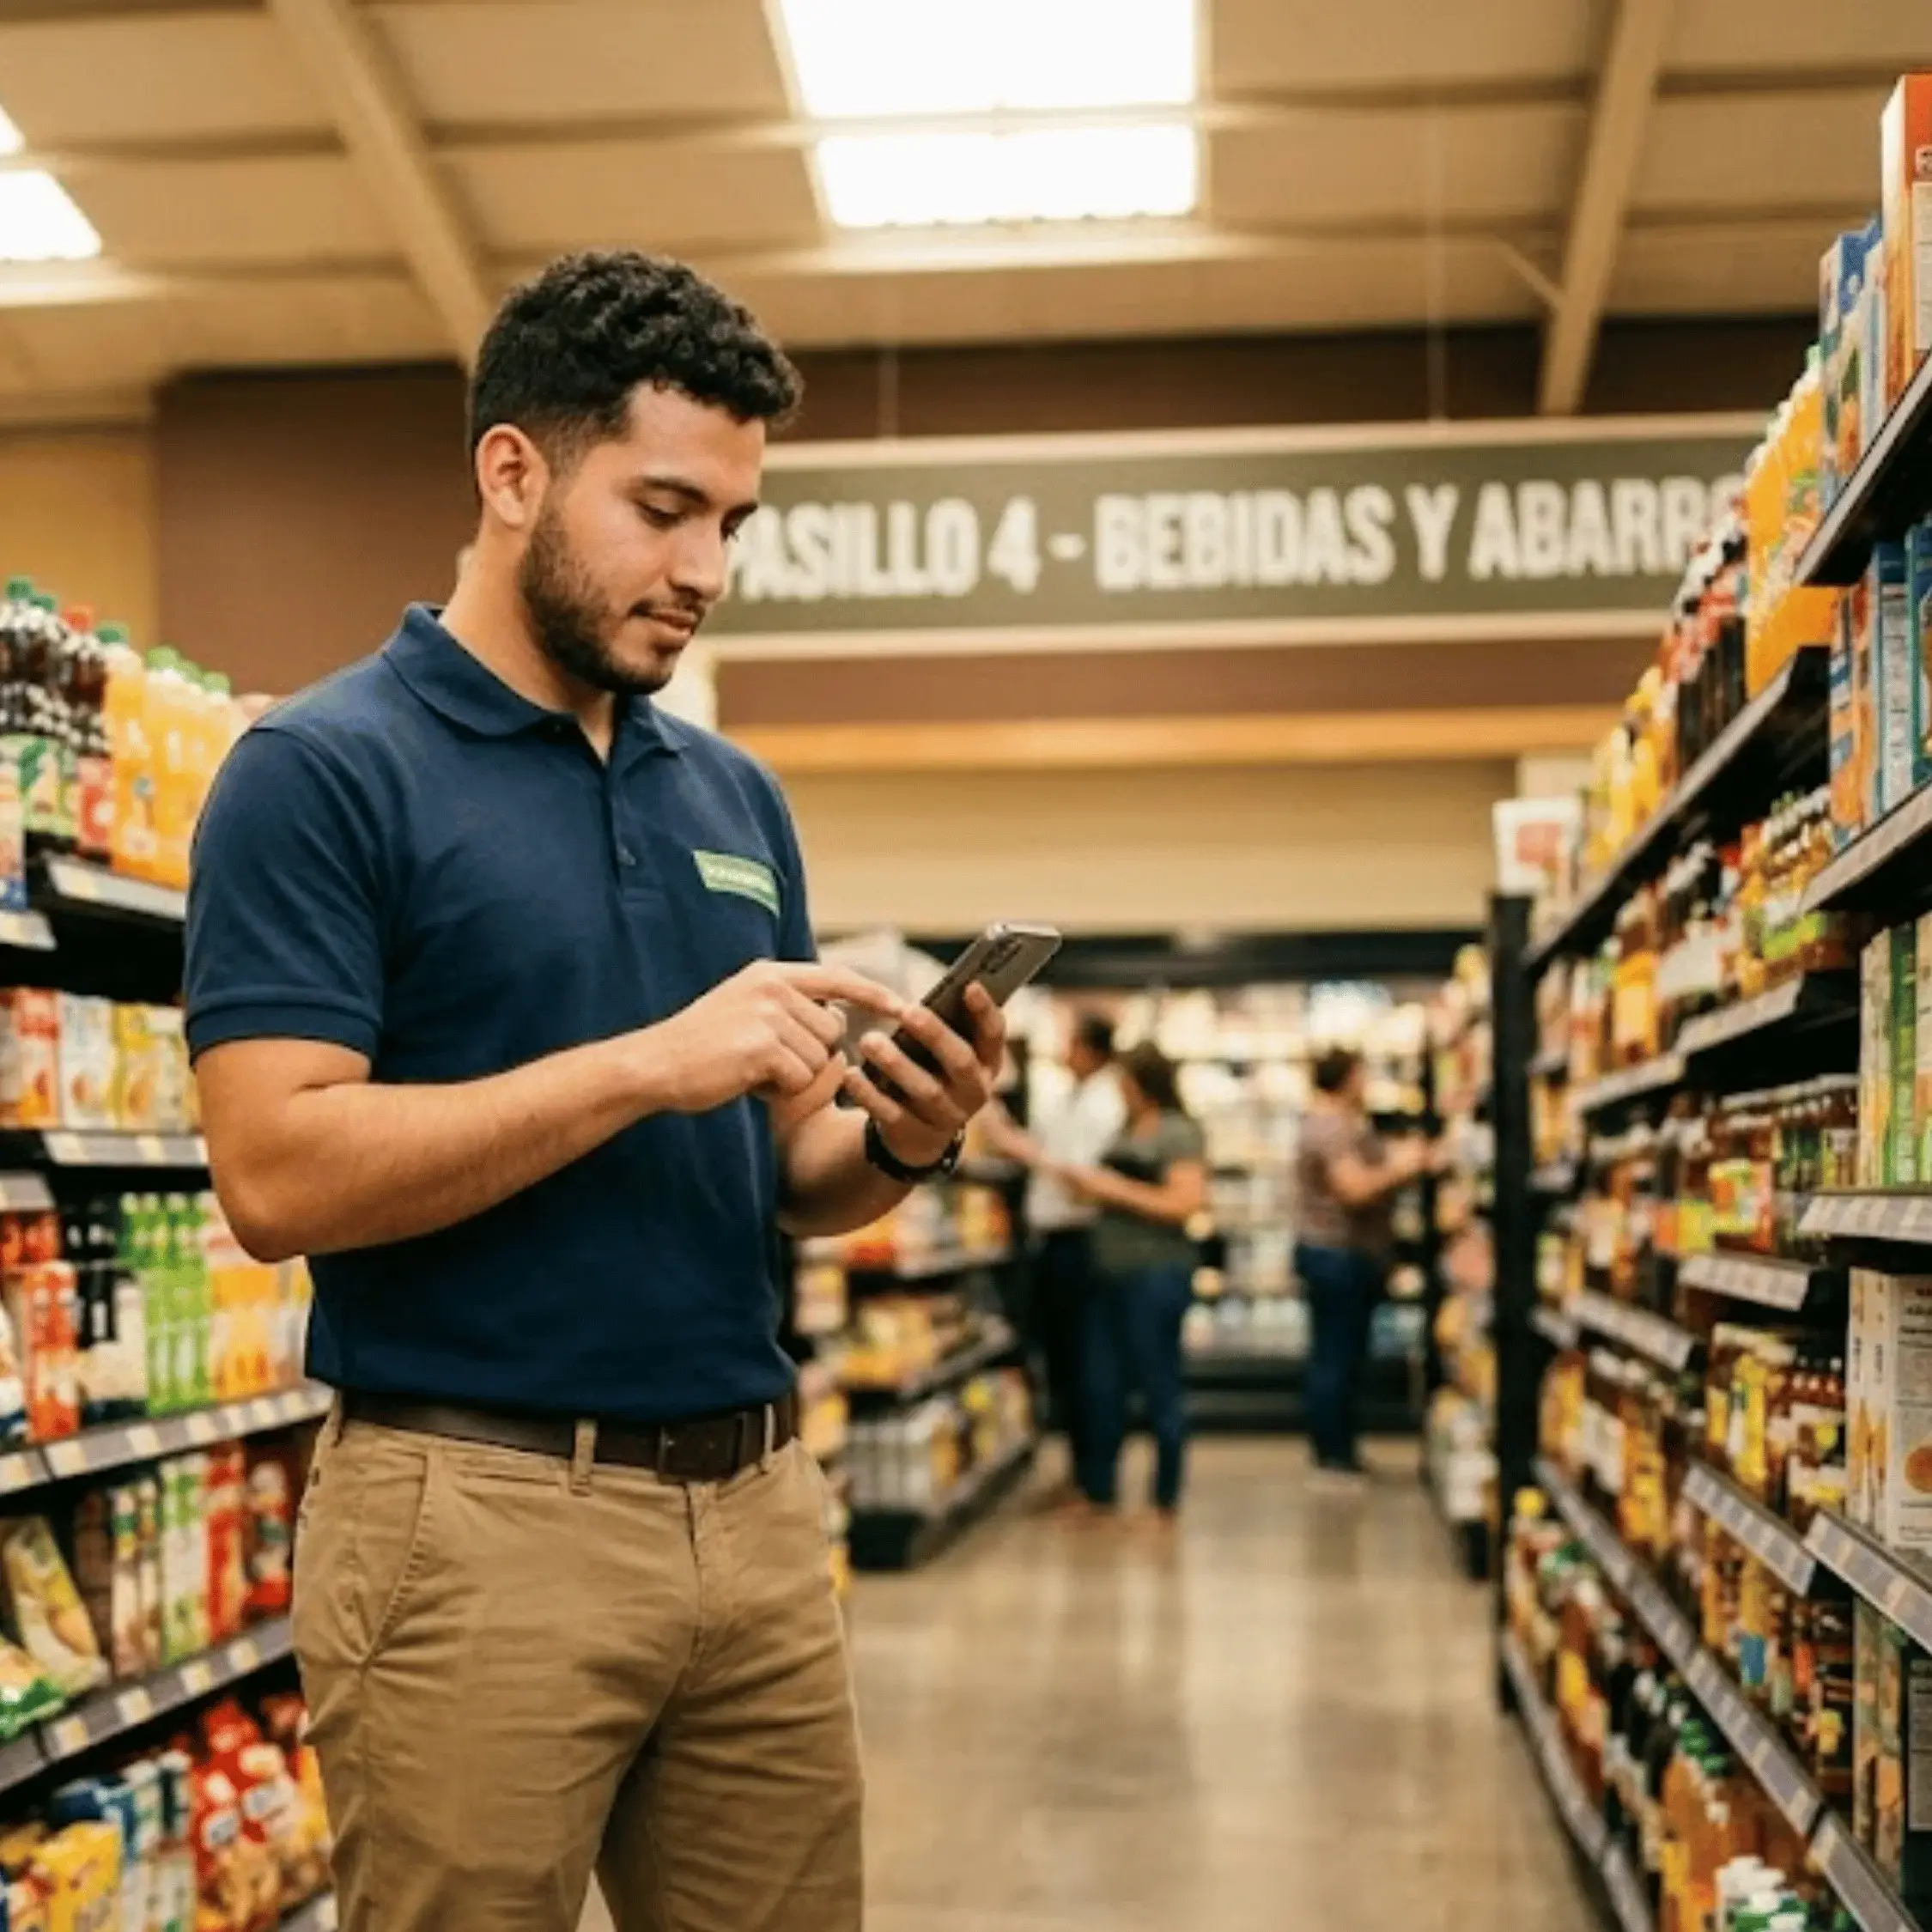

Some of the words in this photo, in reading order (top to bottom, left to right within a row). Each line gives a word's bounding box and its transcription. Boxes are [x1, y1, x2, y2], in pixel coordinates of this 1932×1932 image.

[987, 495, 1041, 593] 4
[1048, 533, 1085, 560] -
[1095, 485, 1396, 590] BEBIDAS
[1405, 483, 1459, 582] Y
